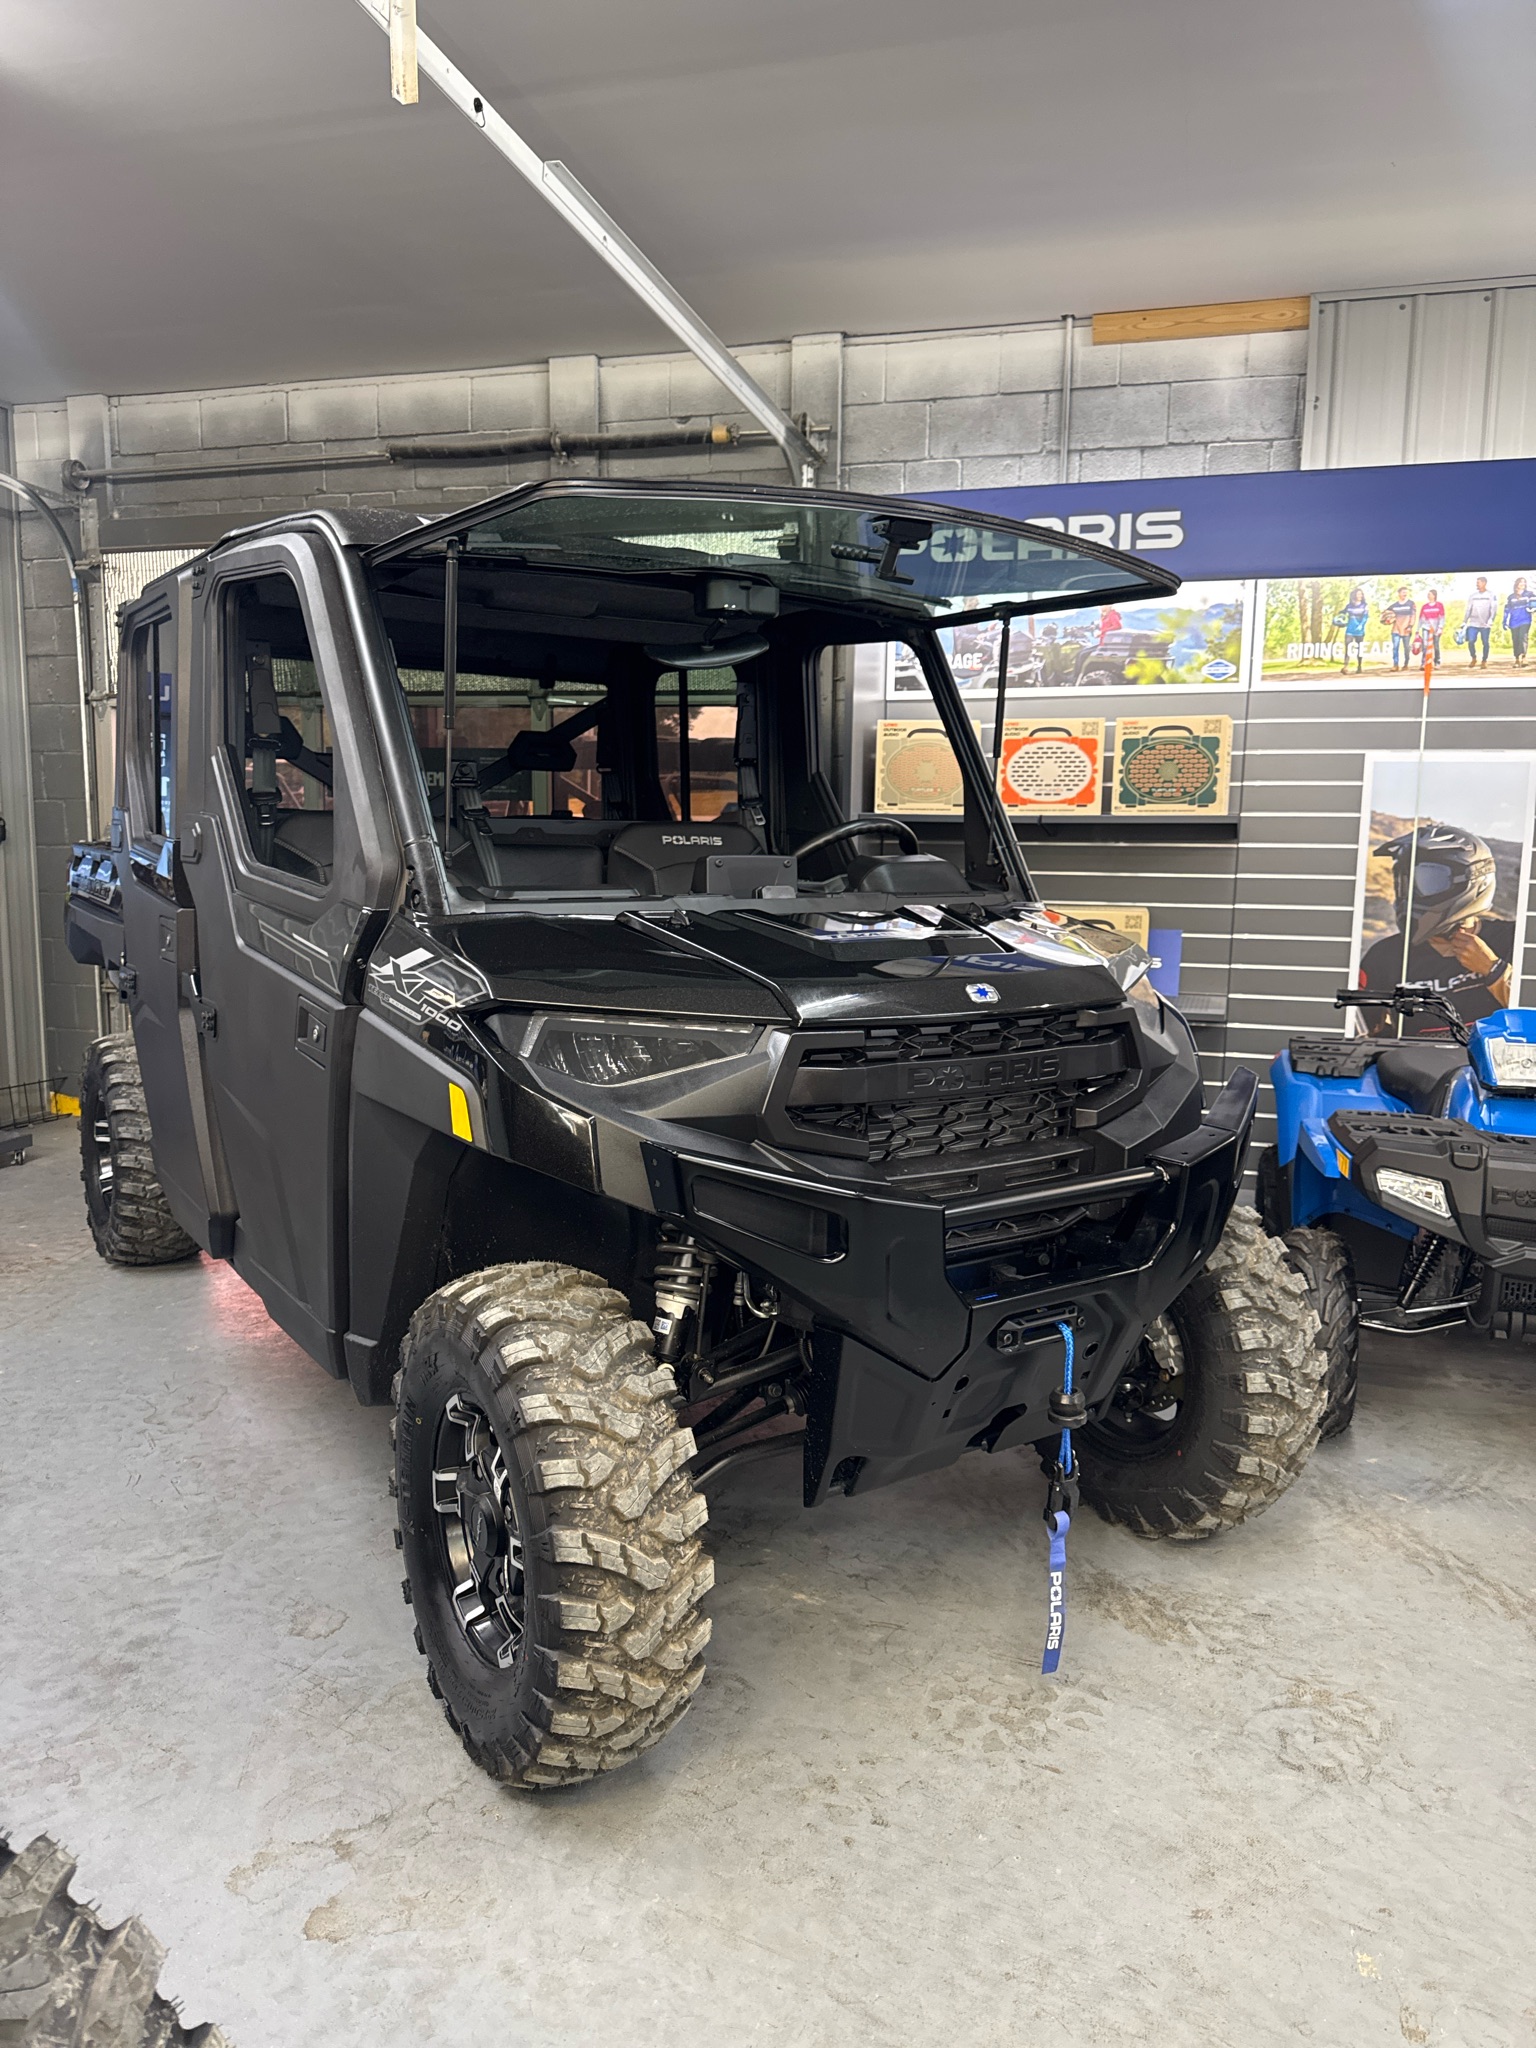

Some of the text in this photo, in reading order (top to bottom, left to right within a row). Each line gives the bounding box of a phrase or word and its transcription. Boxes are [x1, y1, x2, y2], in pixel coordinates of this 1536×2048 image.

[1286, 640, 1394, 659] RIDING GEAR
[662, 835, 723, 846] POLARIS
[420, 1003, 463, 1032] 1000
[906, 1054, 1062, 1094] POLARIS
[1047, 1571, 1062, 1649] POLARIS
